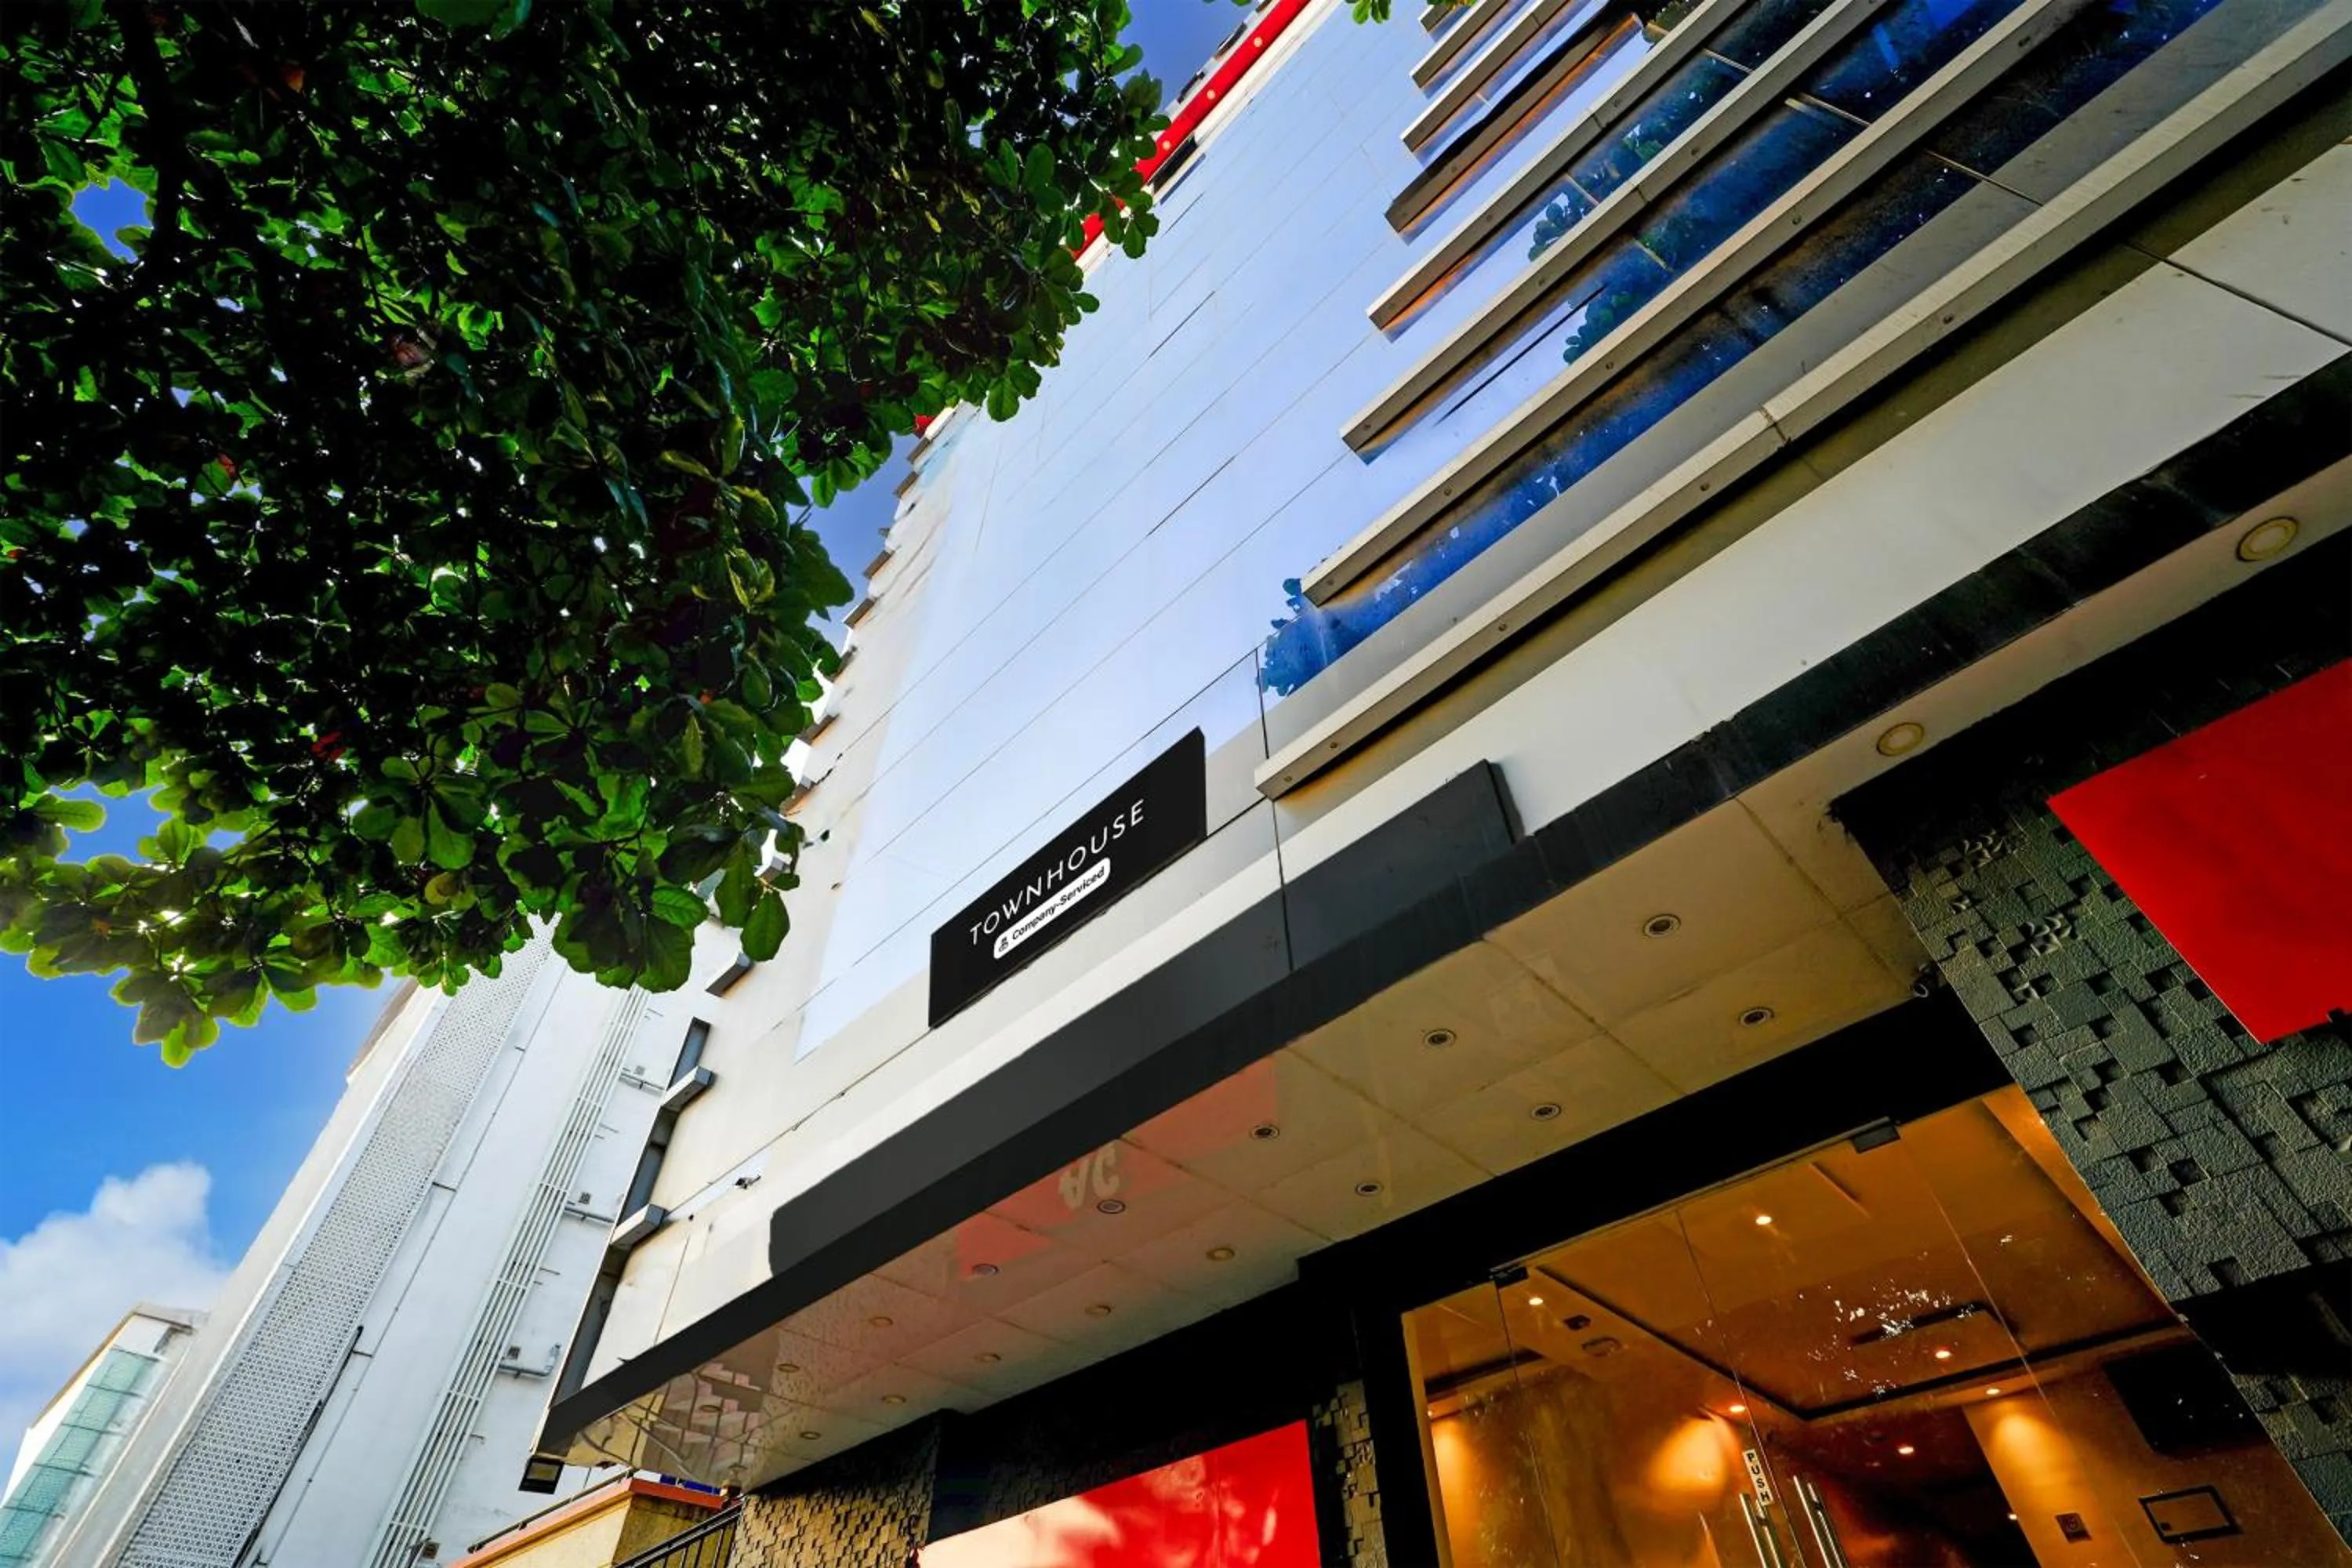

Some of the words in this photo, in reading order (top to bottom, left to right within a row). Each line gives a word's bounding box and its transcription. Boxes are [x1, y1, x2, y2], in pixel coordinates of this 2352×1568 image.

[969, 798, 1145, 946] TOWNHOUSE
[1011, 866, 1105, 941] Company-Serviced
[1746, 1452, 1771, 1501] PUSH
